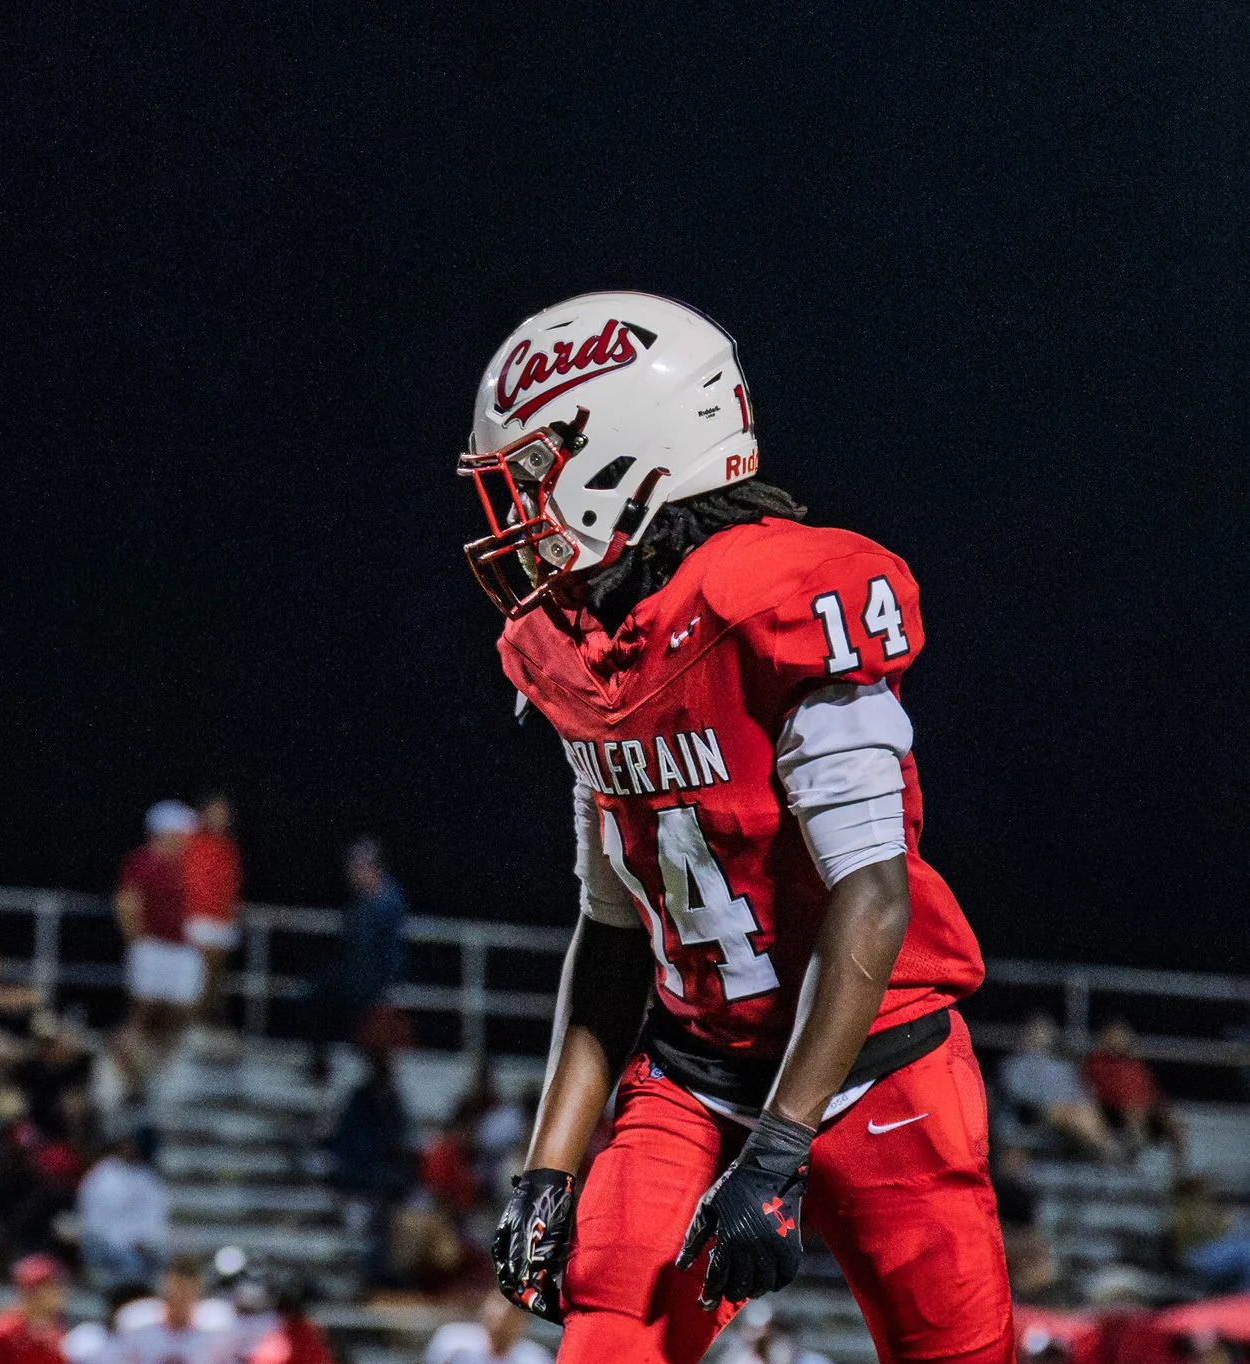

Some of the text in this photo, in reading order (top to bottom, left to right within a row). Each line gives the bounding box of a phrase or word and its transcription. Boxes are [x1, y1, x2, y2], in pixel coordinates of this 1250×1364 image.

[495, 319, 638, 410] Cards
[812, 575, 911, 676] 14
[601, 803, 782, 1001] 14
